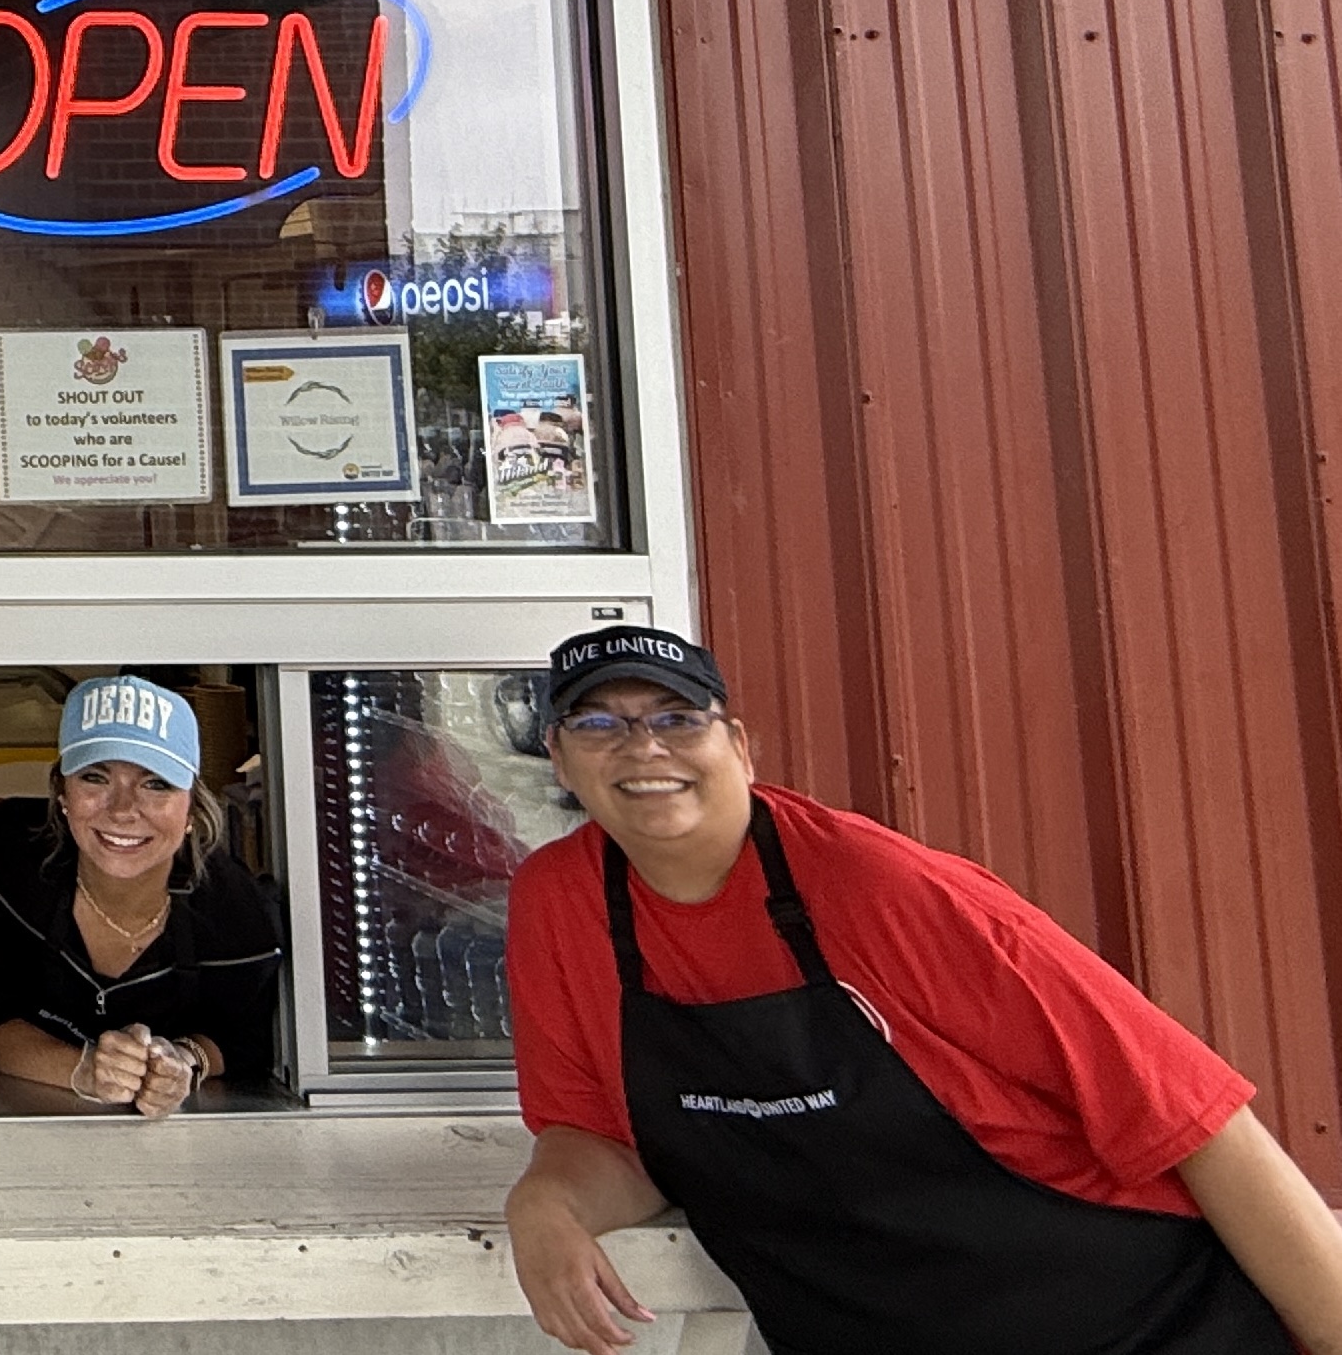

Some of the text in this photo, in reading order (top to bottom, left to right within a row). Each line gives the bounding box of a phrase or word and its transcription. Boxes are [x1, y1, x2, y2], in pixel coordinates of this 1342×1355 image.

[402, 267, 491, 326] pepsi
[58, 390, 144, 404] SHOUT OUT
[26, 412, 177, 428] to today's volunteers
[73, 433, 132, 445] who are
[20, 452, 186, 468] SCOOPING for a Cause!
[53, 475, 71, 485] We
[74, 475, 130, 486] appreciate
[562, 637, 684, 671] LIVE UNITED
[81, 683, 174, 740] DERBY
[680, 1090, 837, 1116] HEARTLAND UNITED WAY
